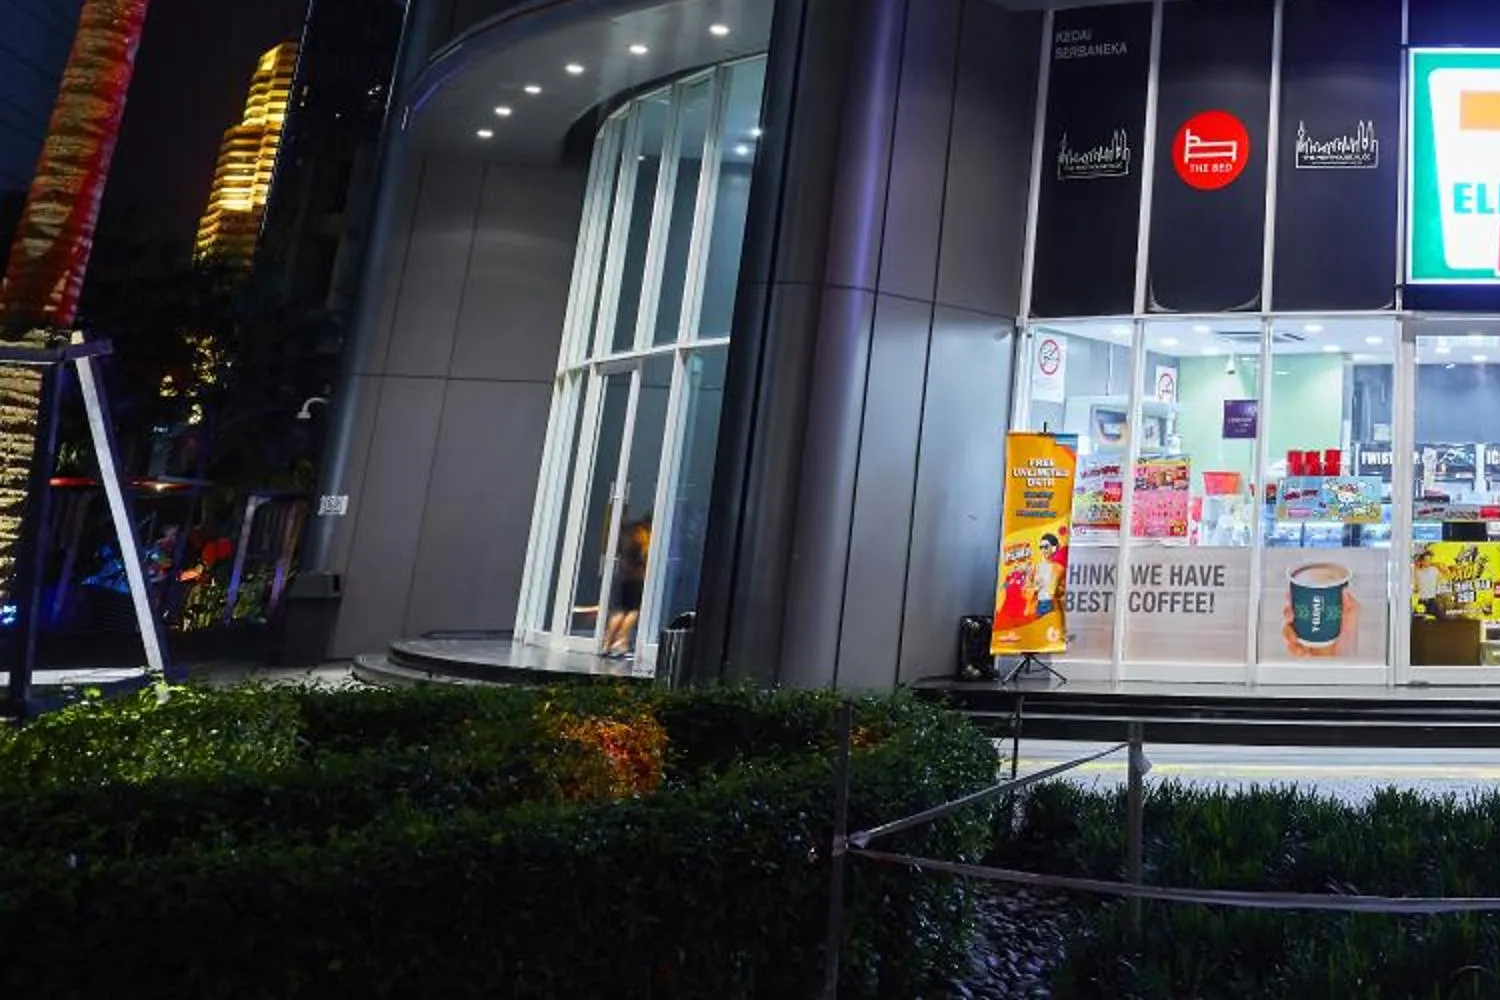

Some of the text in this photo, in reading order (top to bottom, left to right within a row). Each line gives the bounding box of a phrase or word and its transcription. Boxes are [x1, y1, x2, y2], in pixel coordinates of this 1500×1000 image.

[1189, 163, 1233, 173] THE BED
[1068, 564, 1226, 587] HINK WE HAVE
[1065, 591, 1216, 613] BEST COFFEE!
